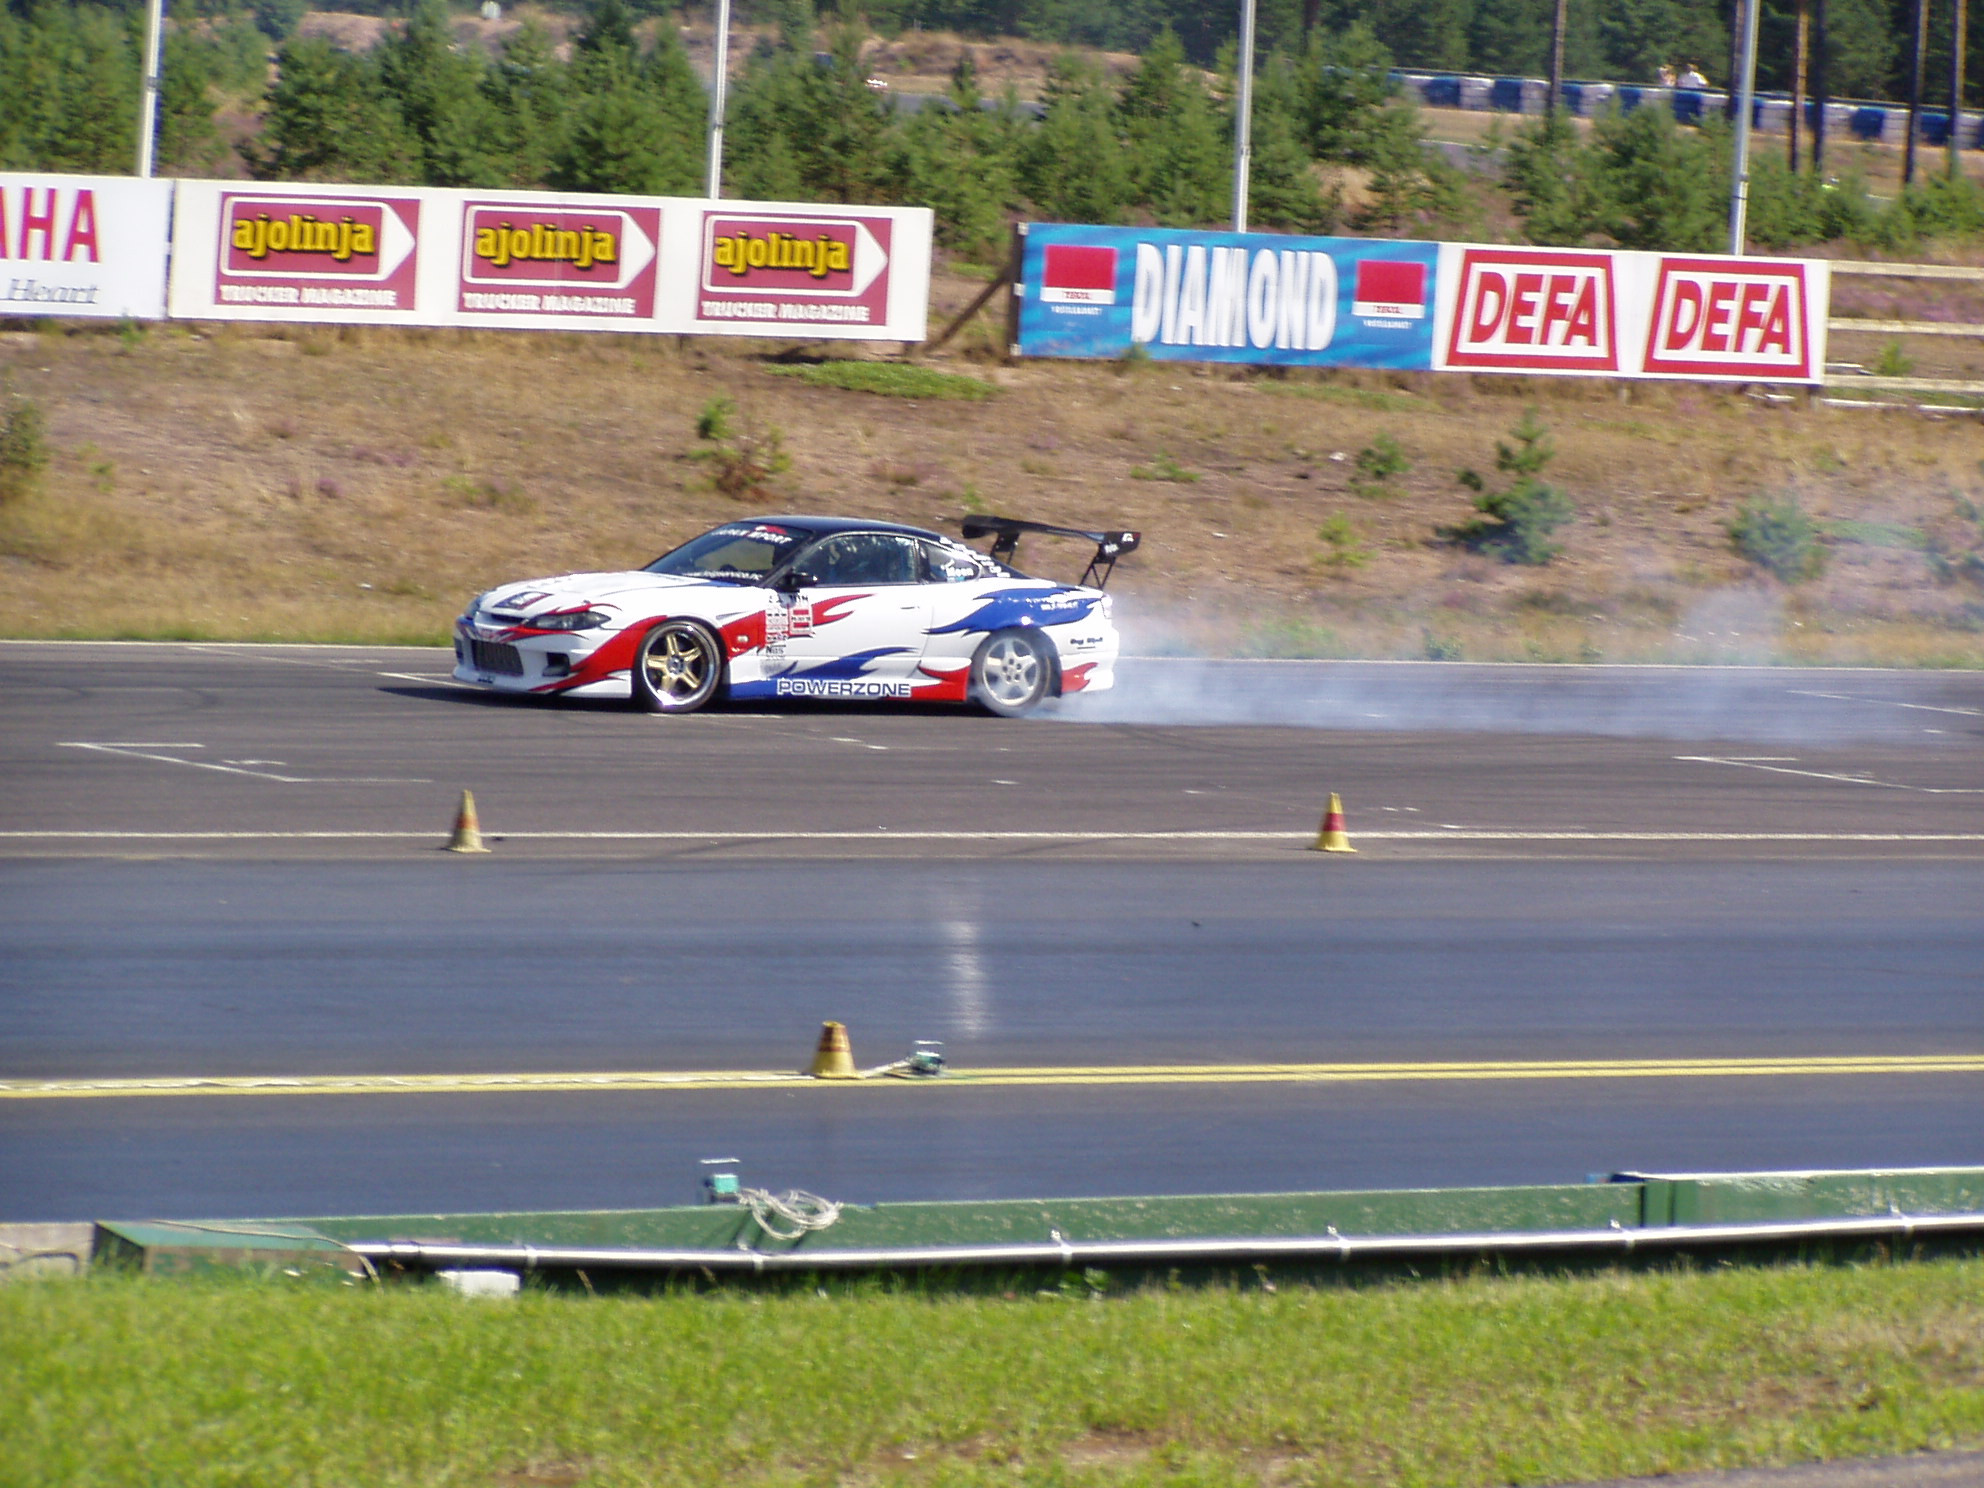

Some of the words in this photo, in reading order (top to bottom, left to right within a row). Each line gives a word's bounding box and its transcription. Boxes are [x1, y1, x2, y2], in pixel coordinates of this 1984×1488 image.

[0, 185, 100, 264] HA
[231, 213, 376, 261] ajolinja
[475, 220, 617, 269] ajolinja
[713, 230, 850, 277] ajolinja
[8, 278, 99, 304] Heart
[219, 284, 300, 304] TRUCKER
[301, 288, 397, 307] MAGAZINE
[462, 292, 542, 312] TRUCKER
[541, 296, 637, 315] MAGAZINE
[701, 300, 778, 320] TRUCKER
[777, 304, 870, 323] MAGAZINE
[1131, 242, 1338, 351] DIAMOND
[1469, 270, 1598, 346] DEFA
[1664, 279, 1792, 354] DEFA
[778, 680, 911, 696] POWERZONE
